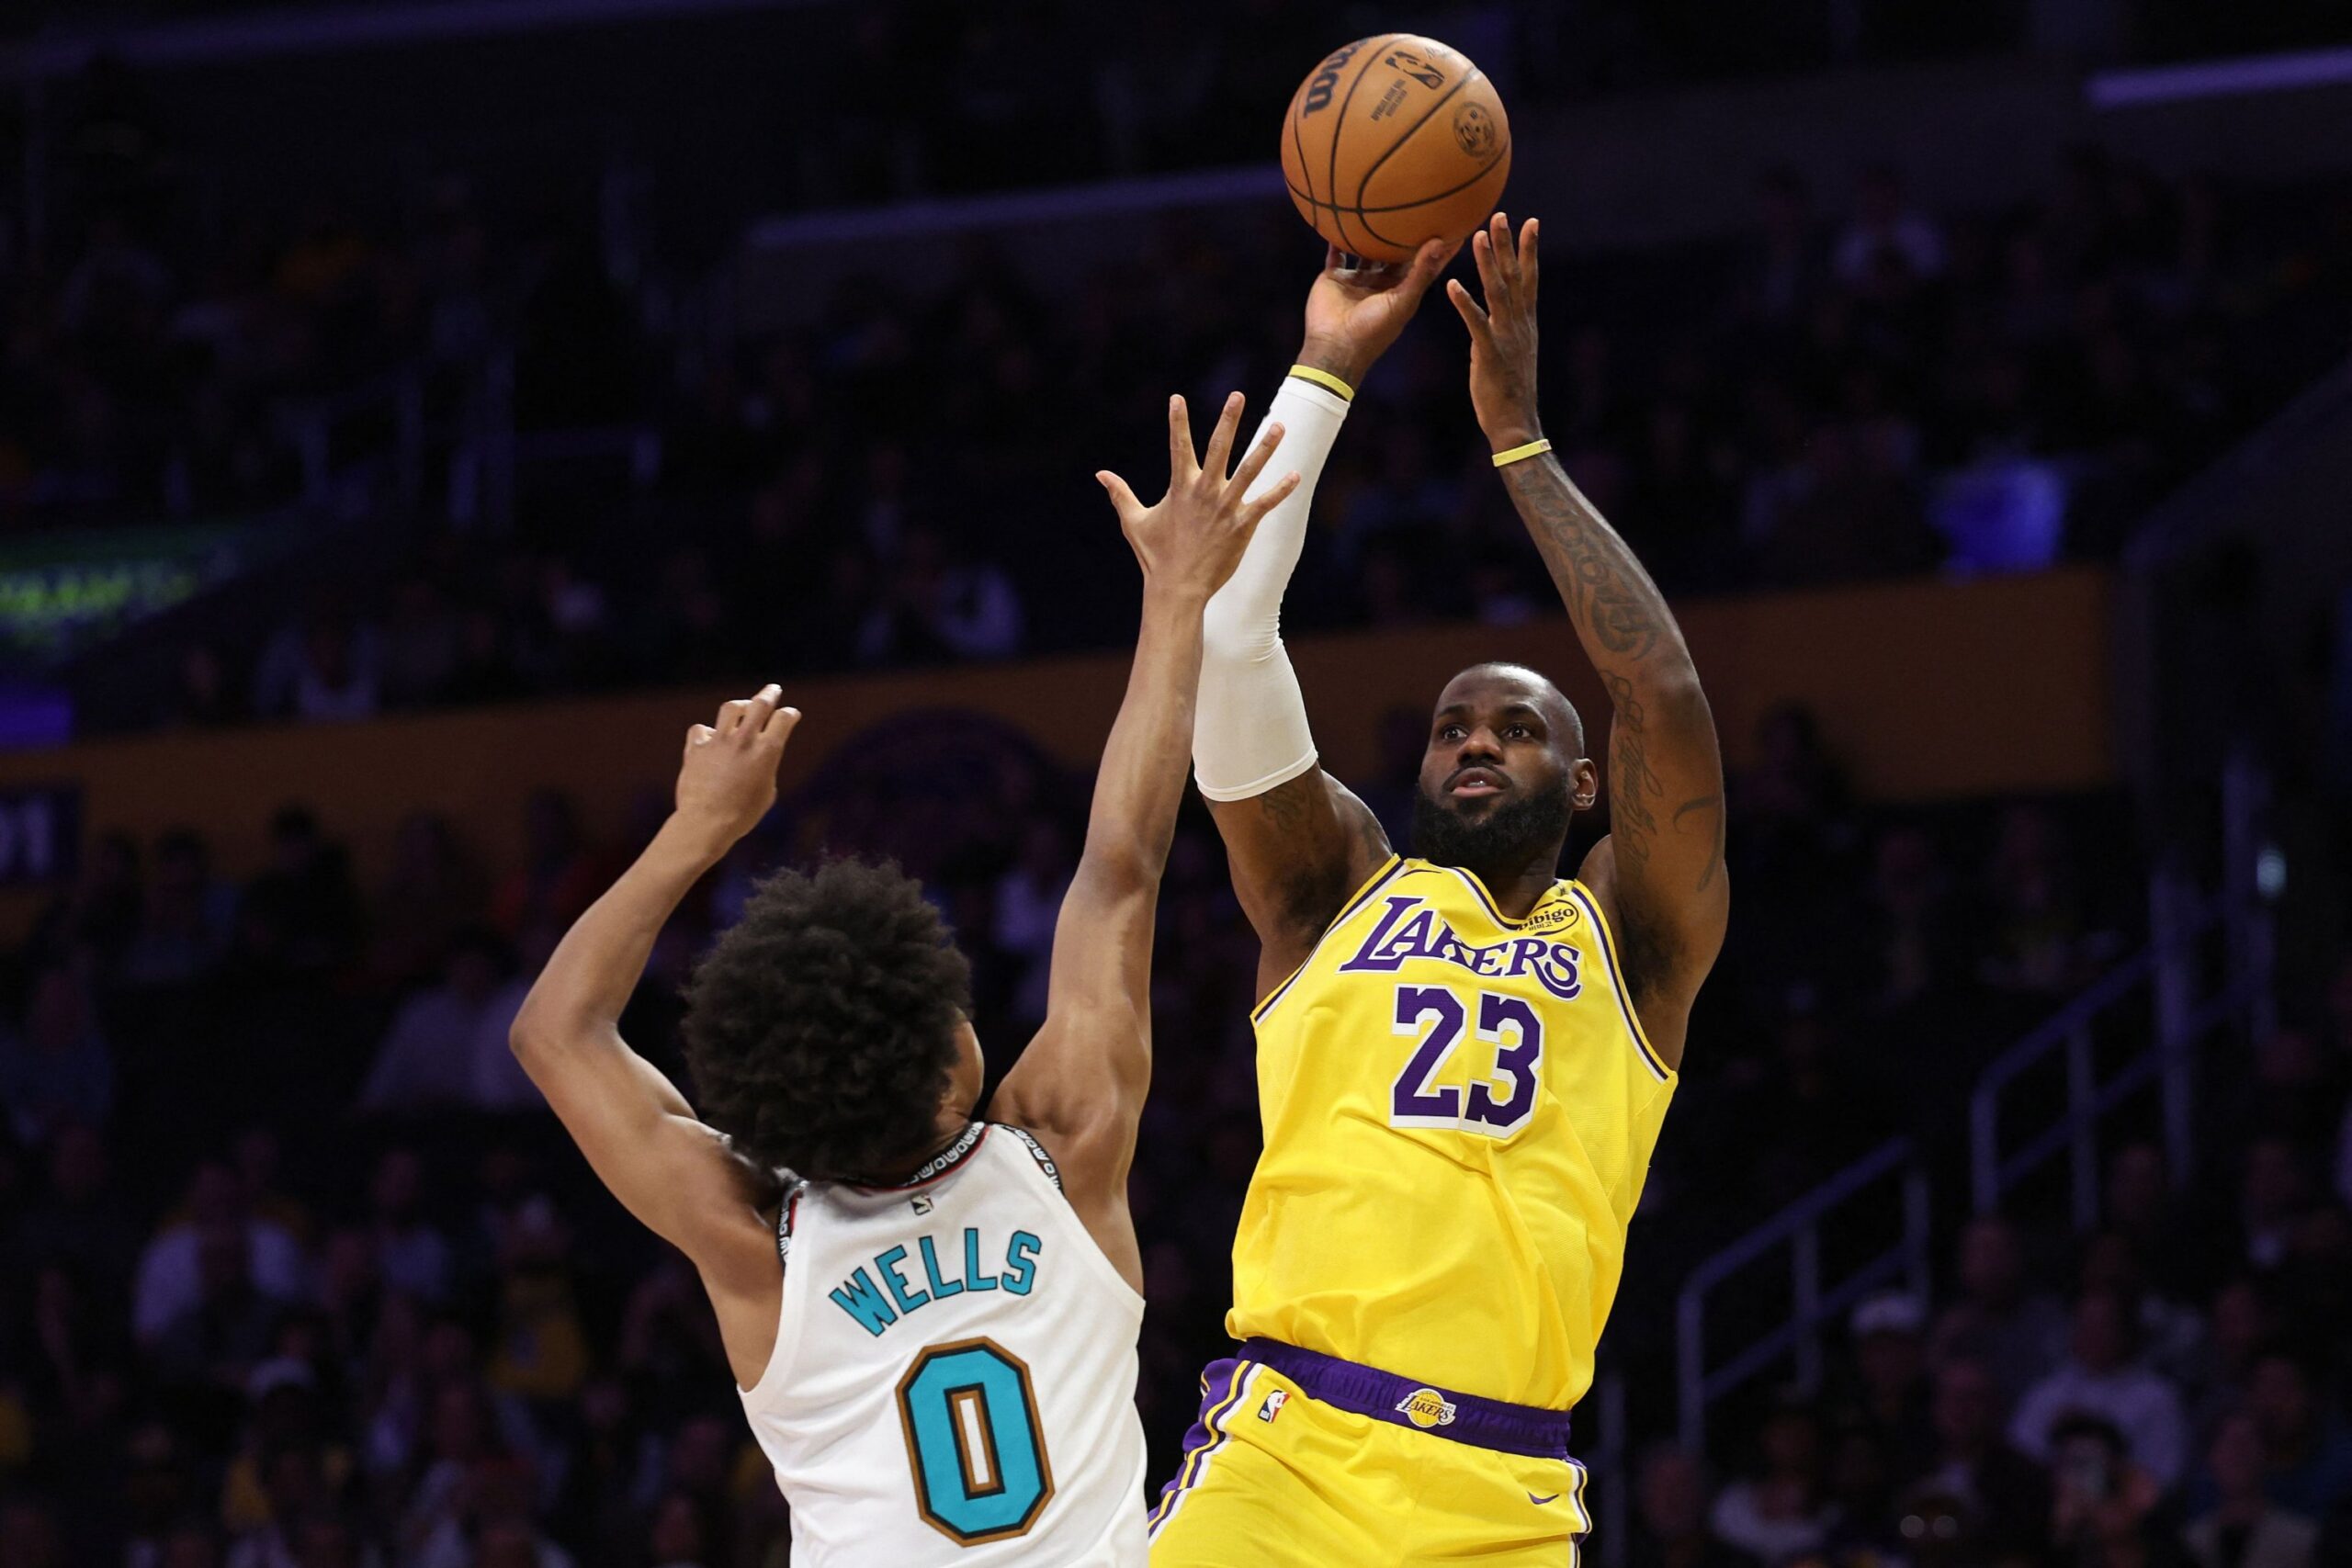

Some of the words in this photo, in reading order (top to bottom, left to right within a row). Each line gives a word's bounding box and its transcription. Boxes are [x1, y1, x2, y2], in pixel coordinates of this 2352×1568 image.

[1337, 896, 1582, 999] LAKERS
[1390, 984, 1545, 1139] 23
[829, 1227, 1042, 1337] WELLS
[895, 1336, 1056, 1548] 0
[1399, 1394, 1453, 1424] LAKERS
